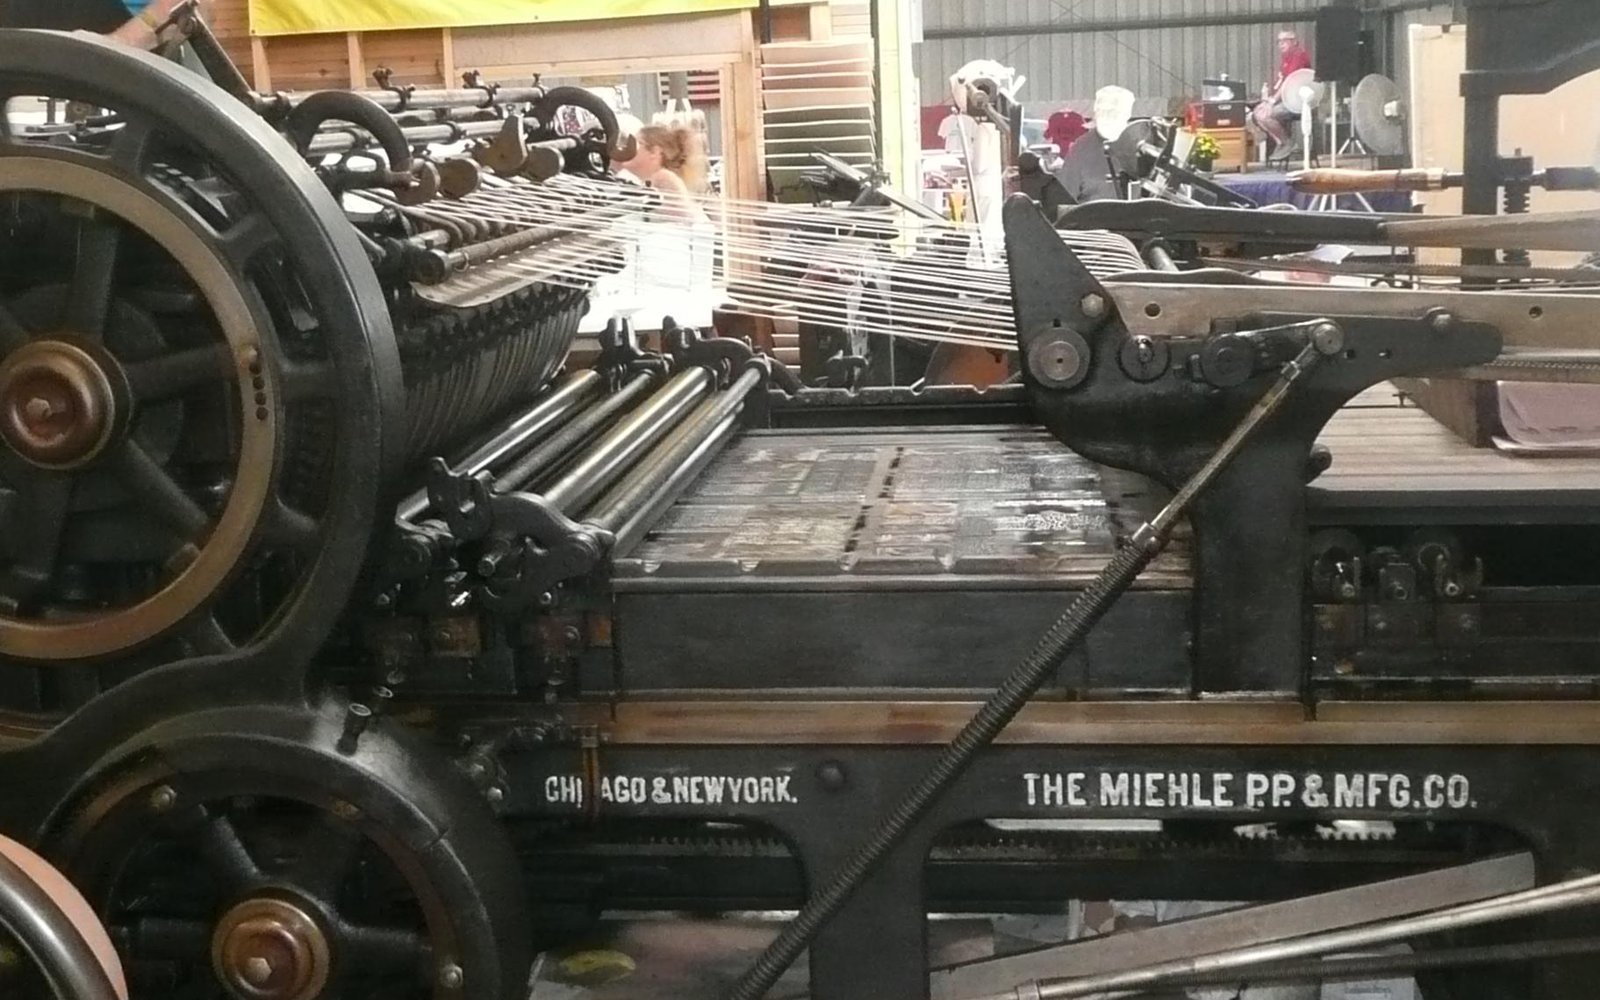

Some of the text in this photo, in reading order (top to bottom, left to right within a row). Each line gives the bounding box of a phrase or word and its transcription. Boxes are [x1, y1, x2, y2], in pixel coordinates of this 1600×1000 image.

[545, 775, 647, 804] CHIAGO
[651, 776, 672, 803] &
[1023, 772, 1087, 806] THE
[1100, 772, 1234, 807] MIEHLE
[1301, 773, 1329, 808] &
